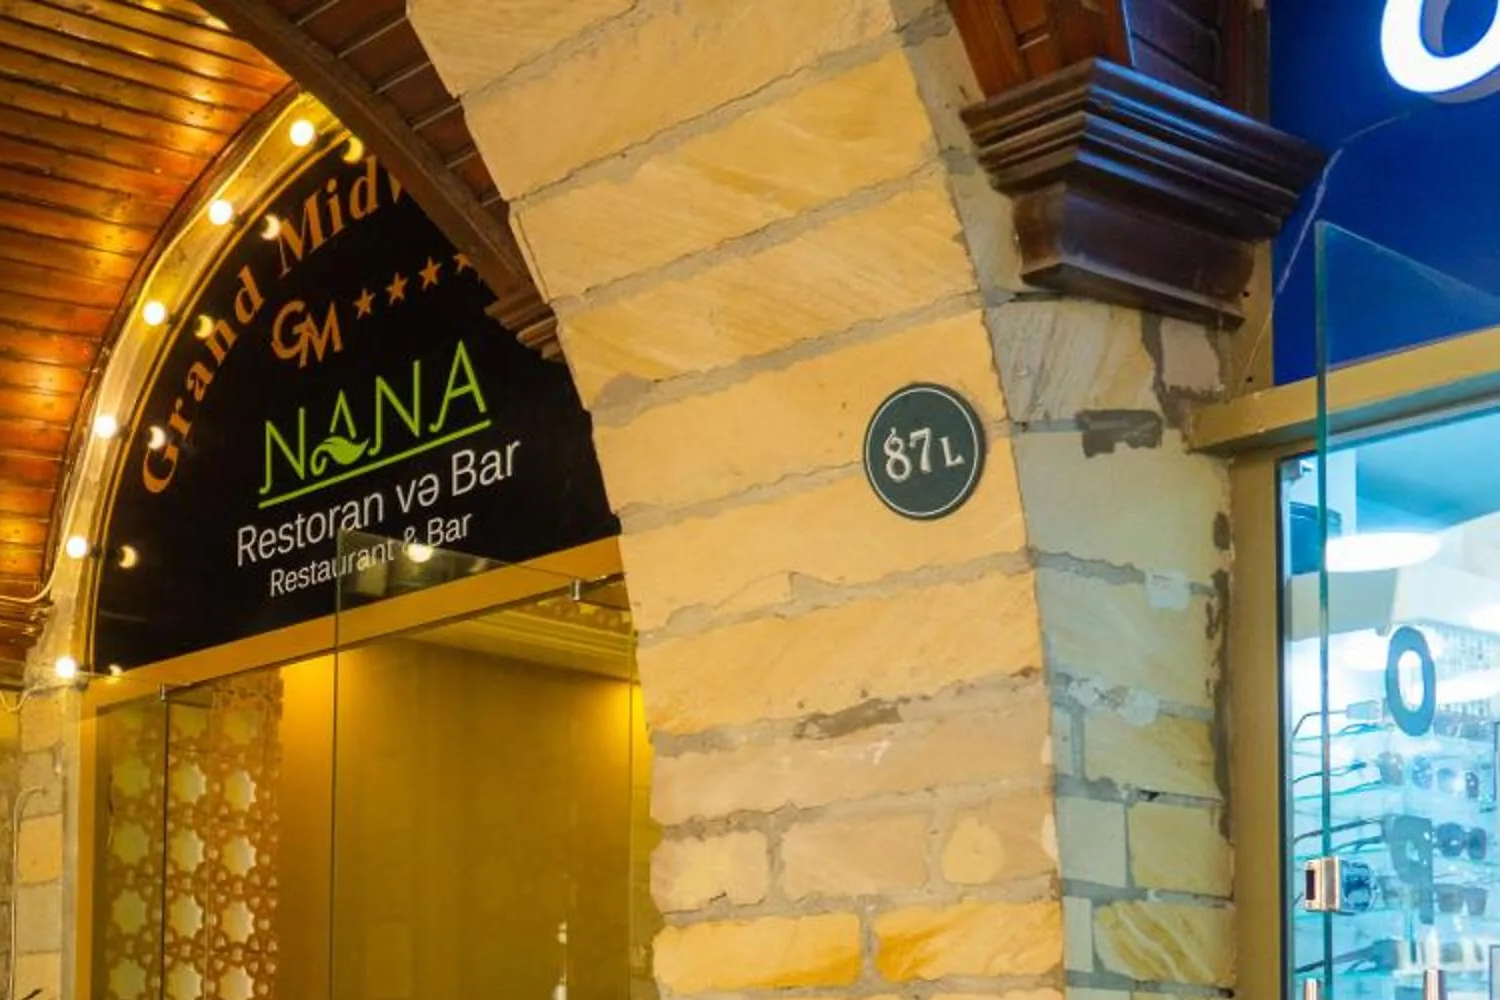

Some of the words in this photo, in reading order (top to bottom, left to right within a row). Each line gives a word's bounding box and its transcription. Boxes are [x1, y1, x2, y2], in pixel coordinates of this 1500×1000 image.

[142, 265, 264, 493] Grand
[277, 154, 400, 278] Mid
[271, 299, 344, 368] GM
[258, 338, 488, 496] NANA
[883, 426, 966, 482] 87L
[236, 491, 385, 568] Restoran
[395, 472, 441, 514] və
[450, 440, 521, 496] Bar
[269, 536, 395, 598] Restaurant
[426, 512, 473, 548] Bar
